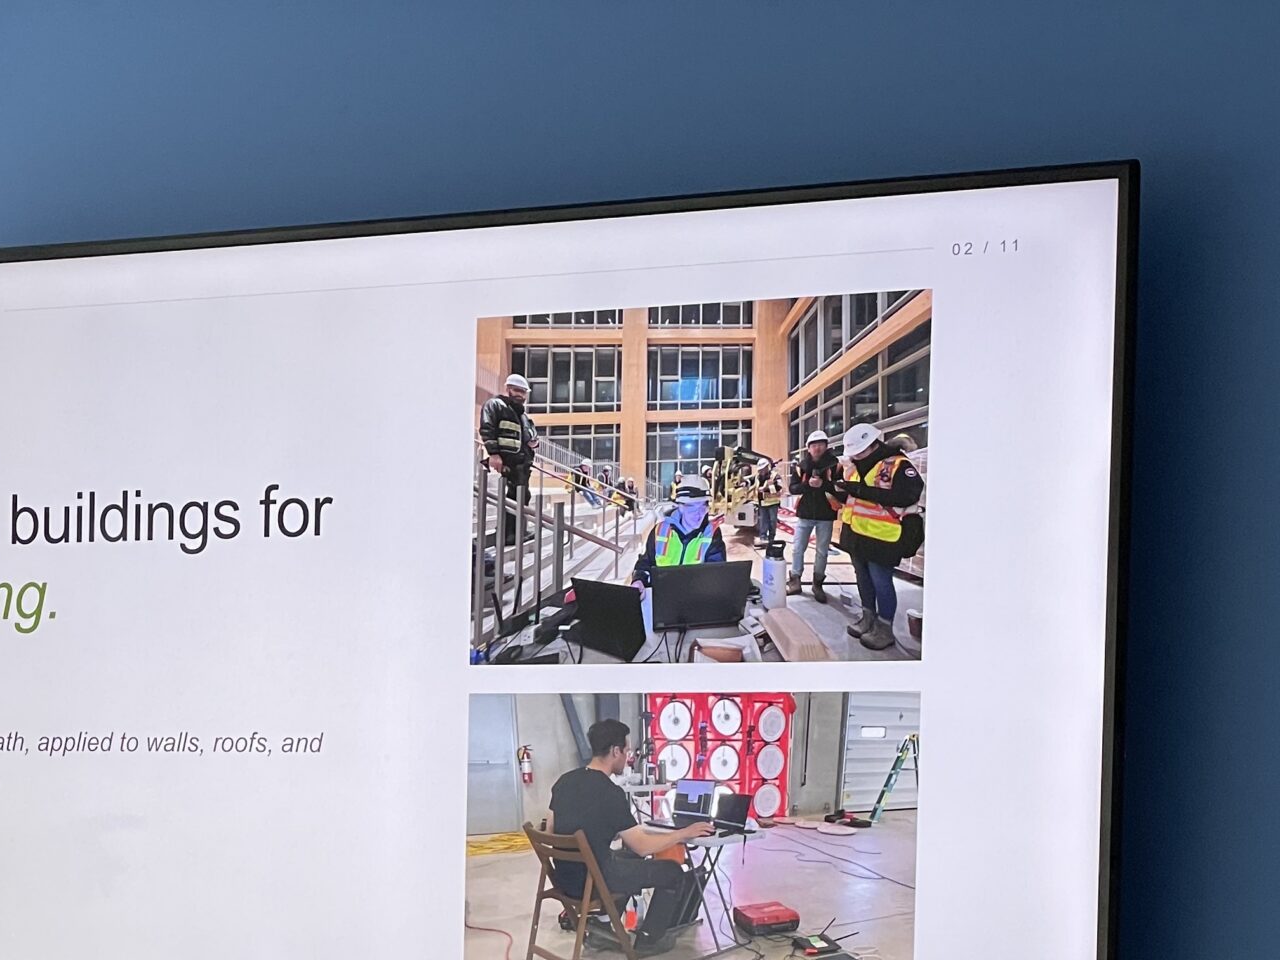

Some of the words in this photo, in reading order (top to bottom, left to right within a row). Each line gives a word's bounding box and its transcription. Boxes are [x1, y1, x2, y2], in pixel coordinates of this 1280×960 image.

[952, 242, 973, 256] 02
[983, 241, 989, 254] /
[1000, 239, 1018, 252] 11
[11, 489, 241, 555] buildings
[260, 484, 333, 538] for
[37, 731, 113, 757] applied
[120, 733, 139, 752] to
[146, 732, 205, 756] walls,
[213, 731, 273, 756] roofs,
[281, 732, 324, 754] and
